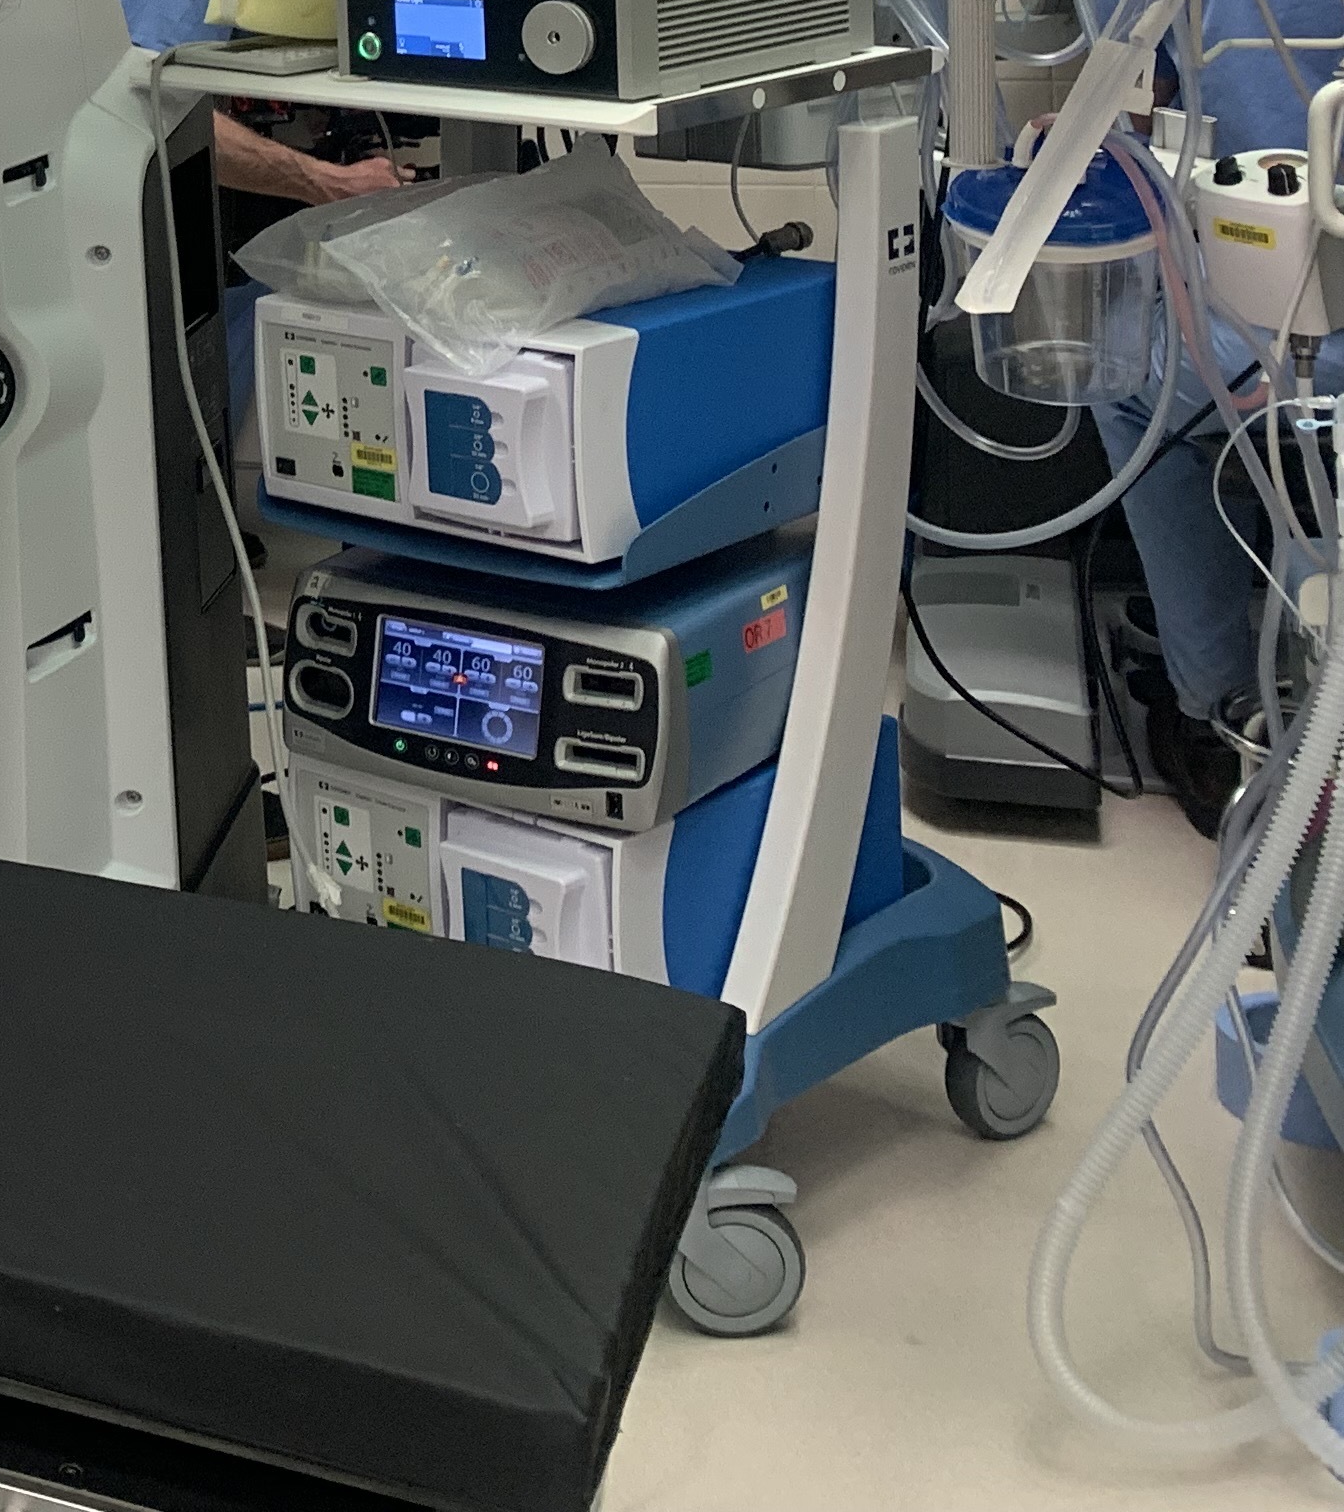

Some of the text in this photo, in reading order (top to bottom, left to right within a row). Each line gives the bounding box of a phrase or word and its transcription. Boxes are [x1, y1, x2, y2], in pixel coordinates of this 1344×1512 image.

[392, 641, 534, 681] 40 40 60 60
